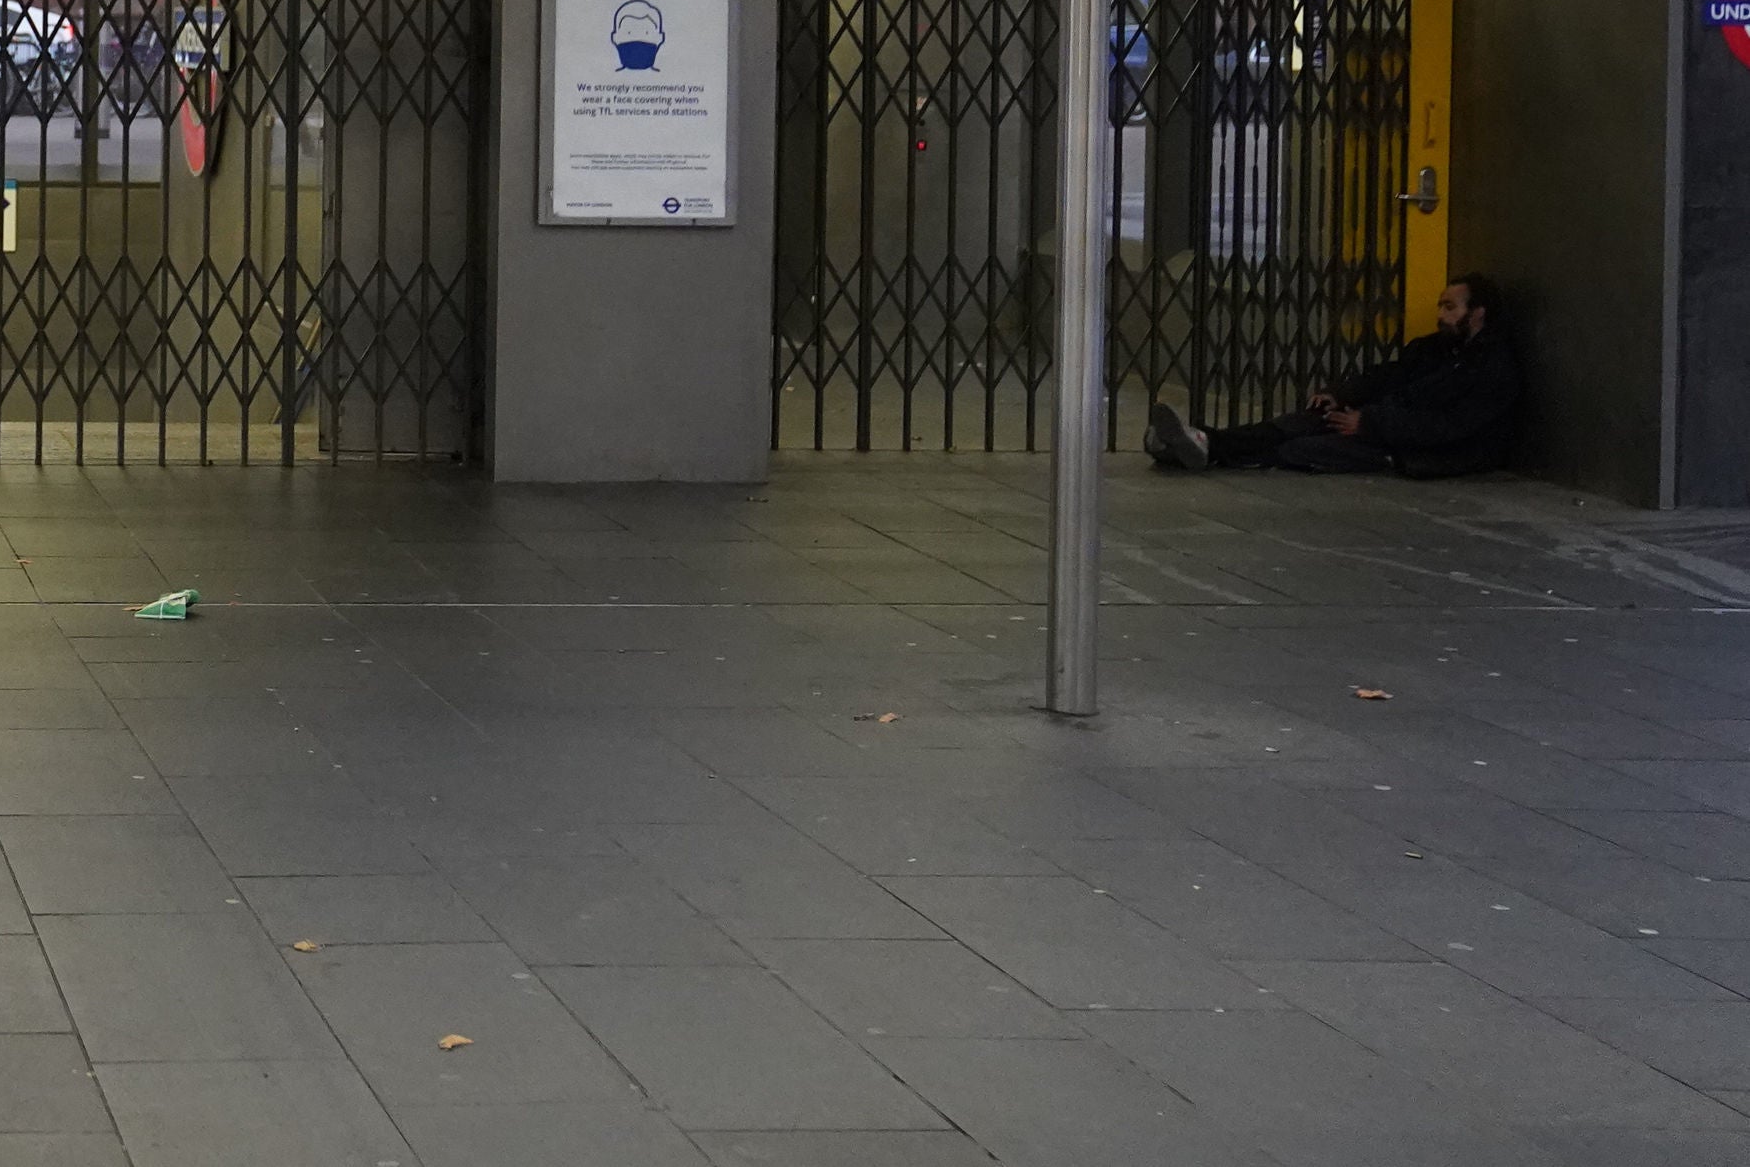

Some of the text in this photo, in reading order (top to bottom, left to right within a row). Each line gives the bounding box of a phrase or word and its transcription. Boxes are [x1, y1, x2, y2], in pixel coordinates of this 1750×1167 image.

[577, 83, 705, 94] We strongly recommend you
[613, 95, 632, 104] face
[634, 95, 672, 106] covering
[674, 95, 699, 104] when
[573, 107, 708, 118] using TfL services and stations
